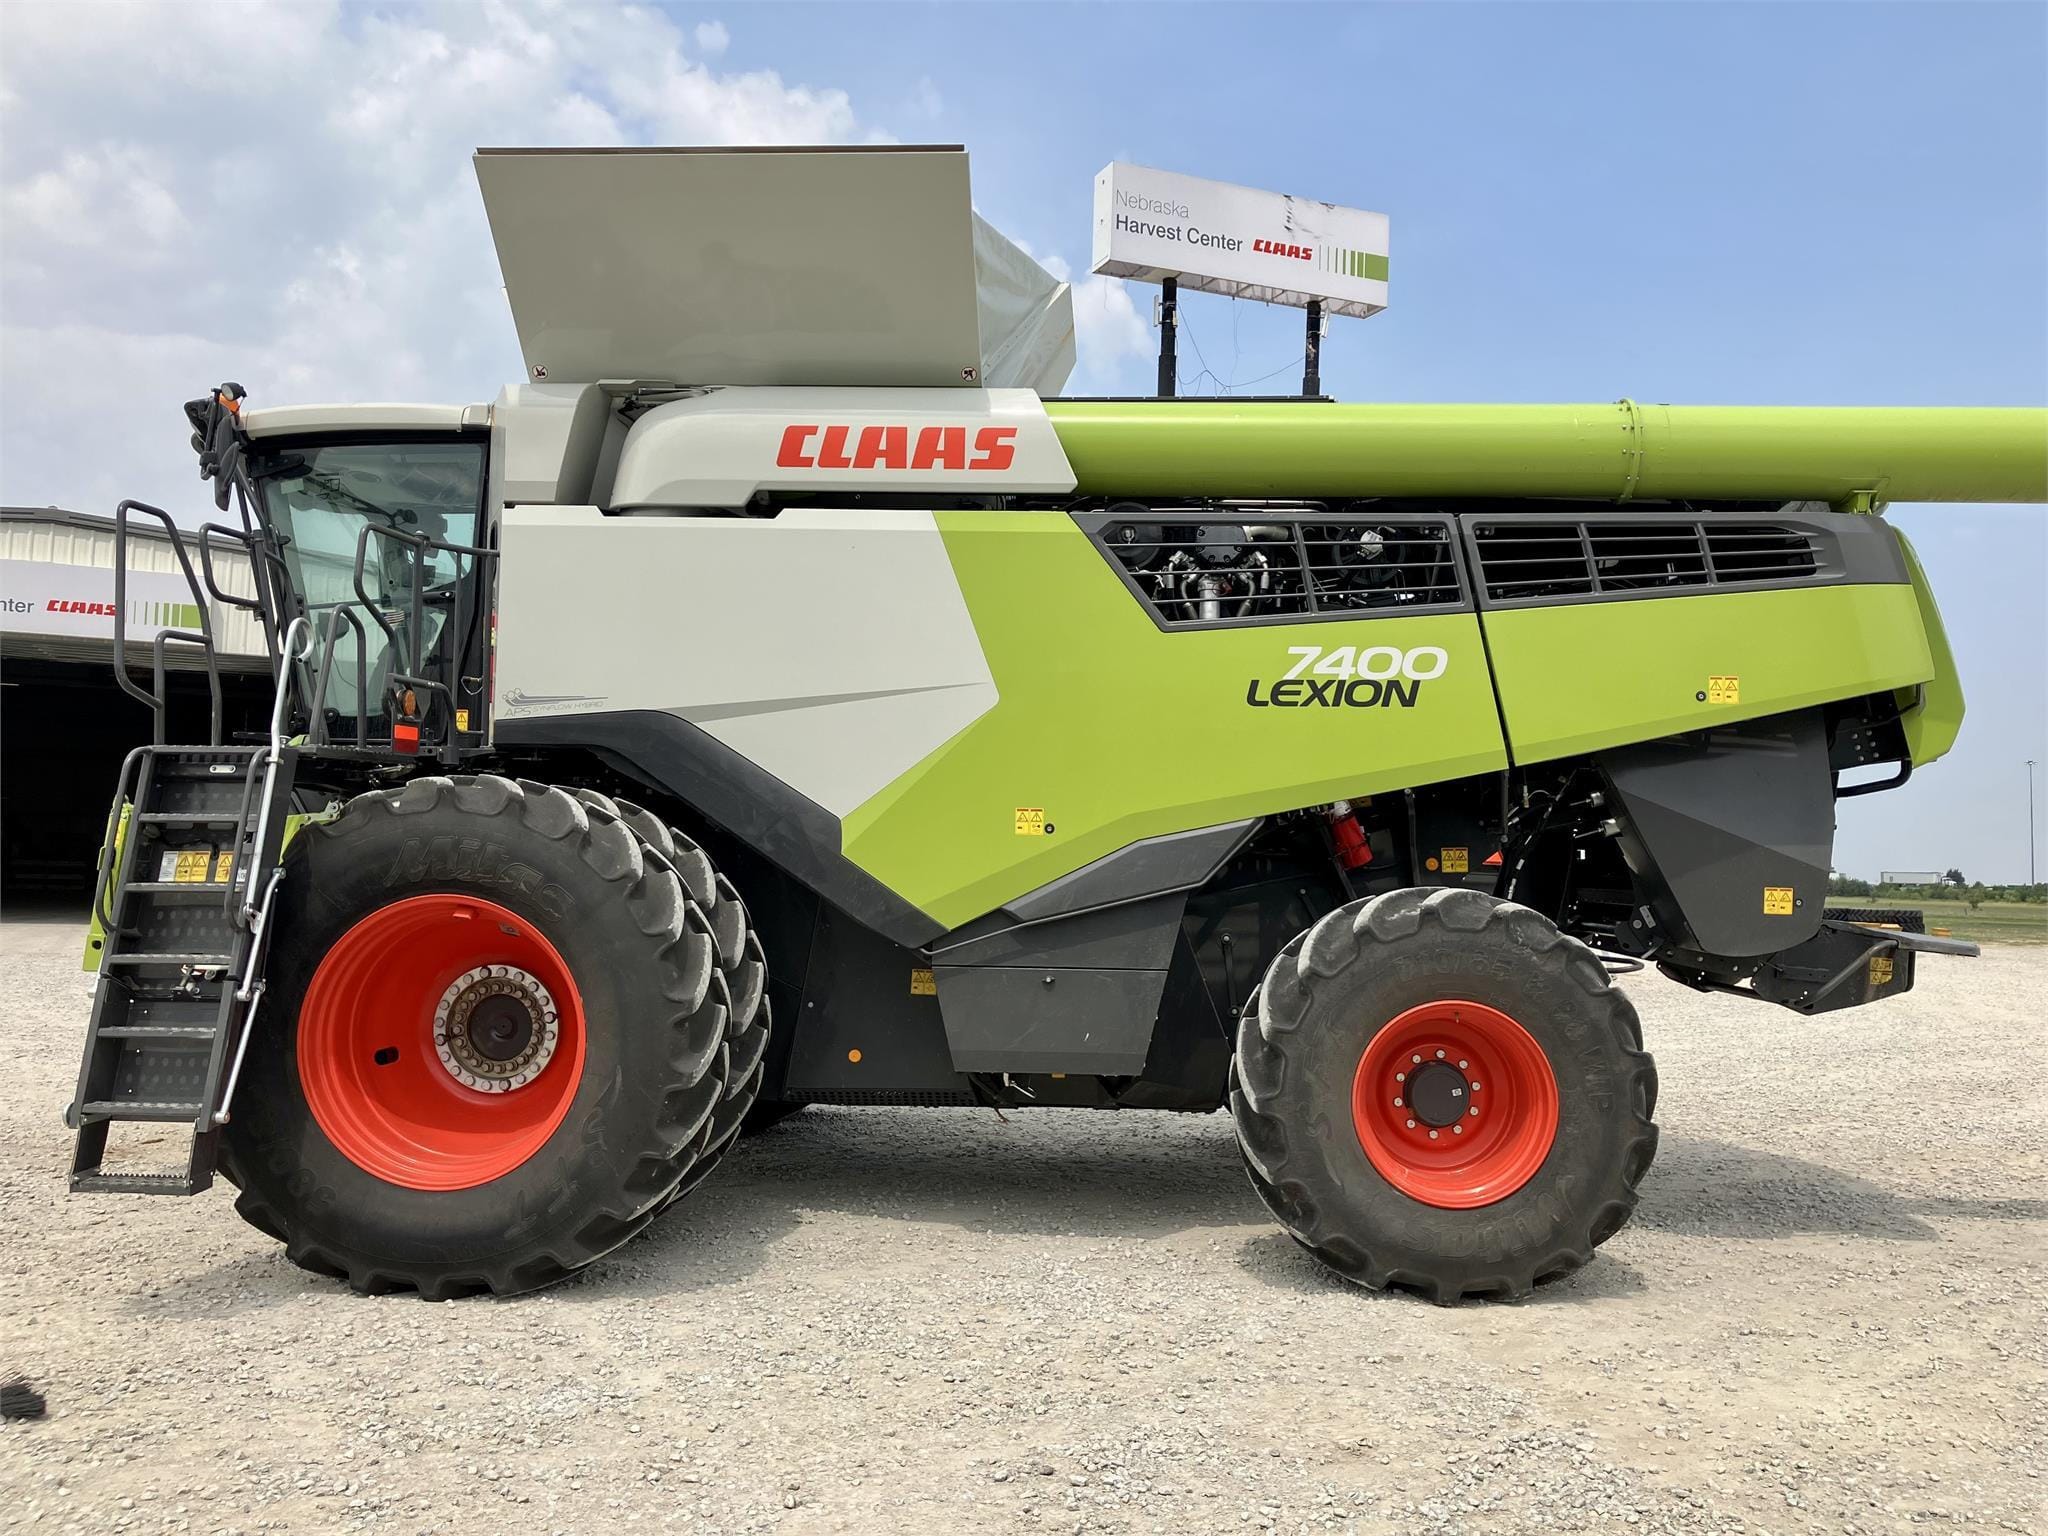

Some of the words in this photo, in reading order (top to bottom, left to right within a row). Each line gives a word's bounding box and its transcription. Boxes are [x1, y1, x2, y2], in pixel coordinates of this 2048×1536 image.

[1115, 188, 1190, 219] Nebraska
[1115, 213, 1182, 242] Harvest
[1186, 227, 1244, 252] Center
[1252, 238, 1313, 261] CLAAS
[775, 424, 1019, 471] CLAAS
[1281, 645, 1449, 681] 7400
[1246, 678, 1422, 708] LEXION
